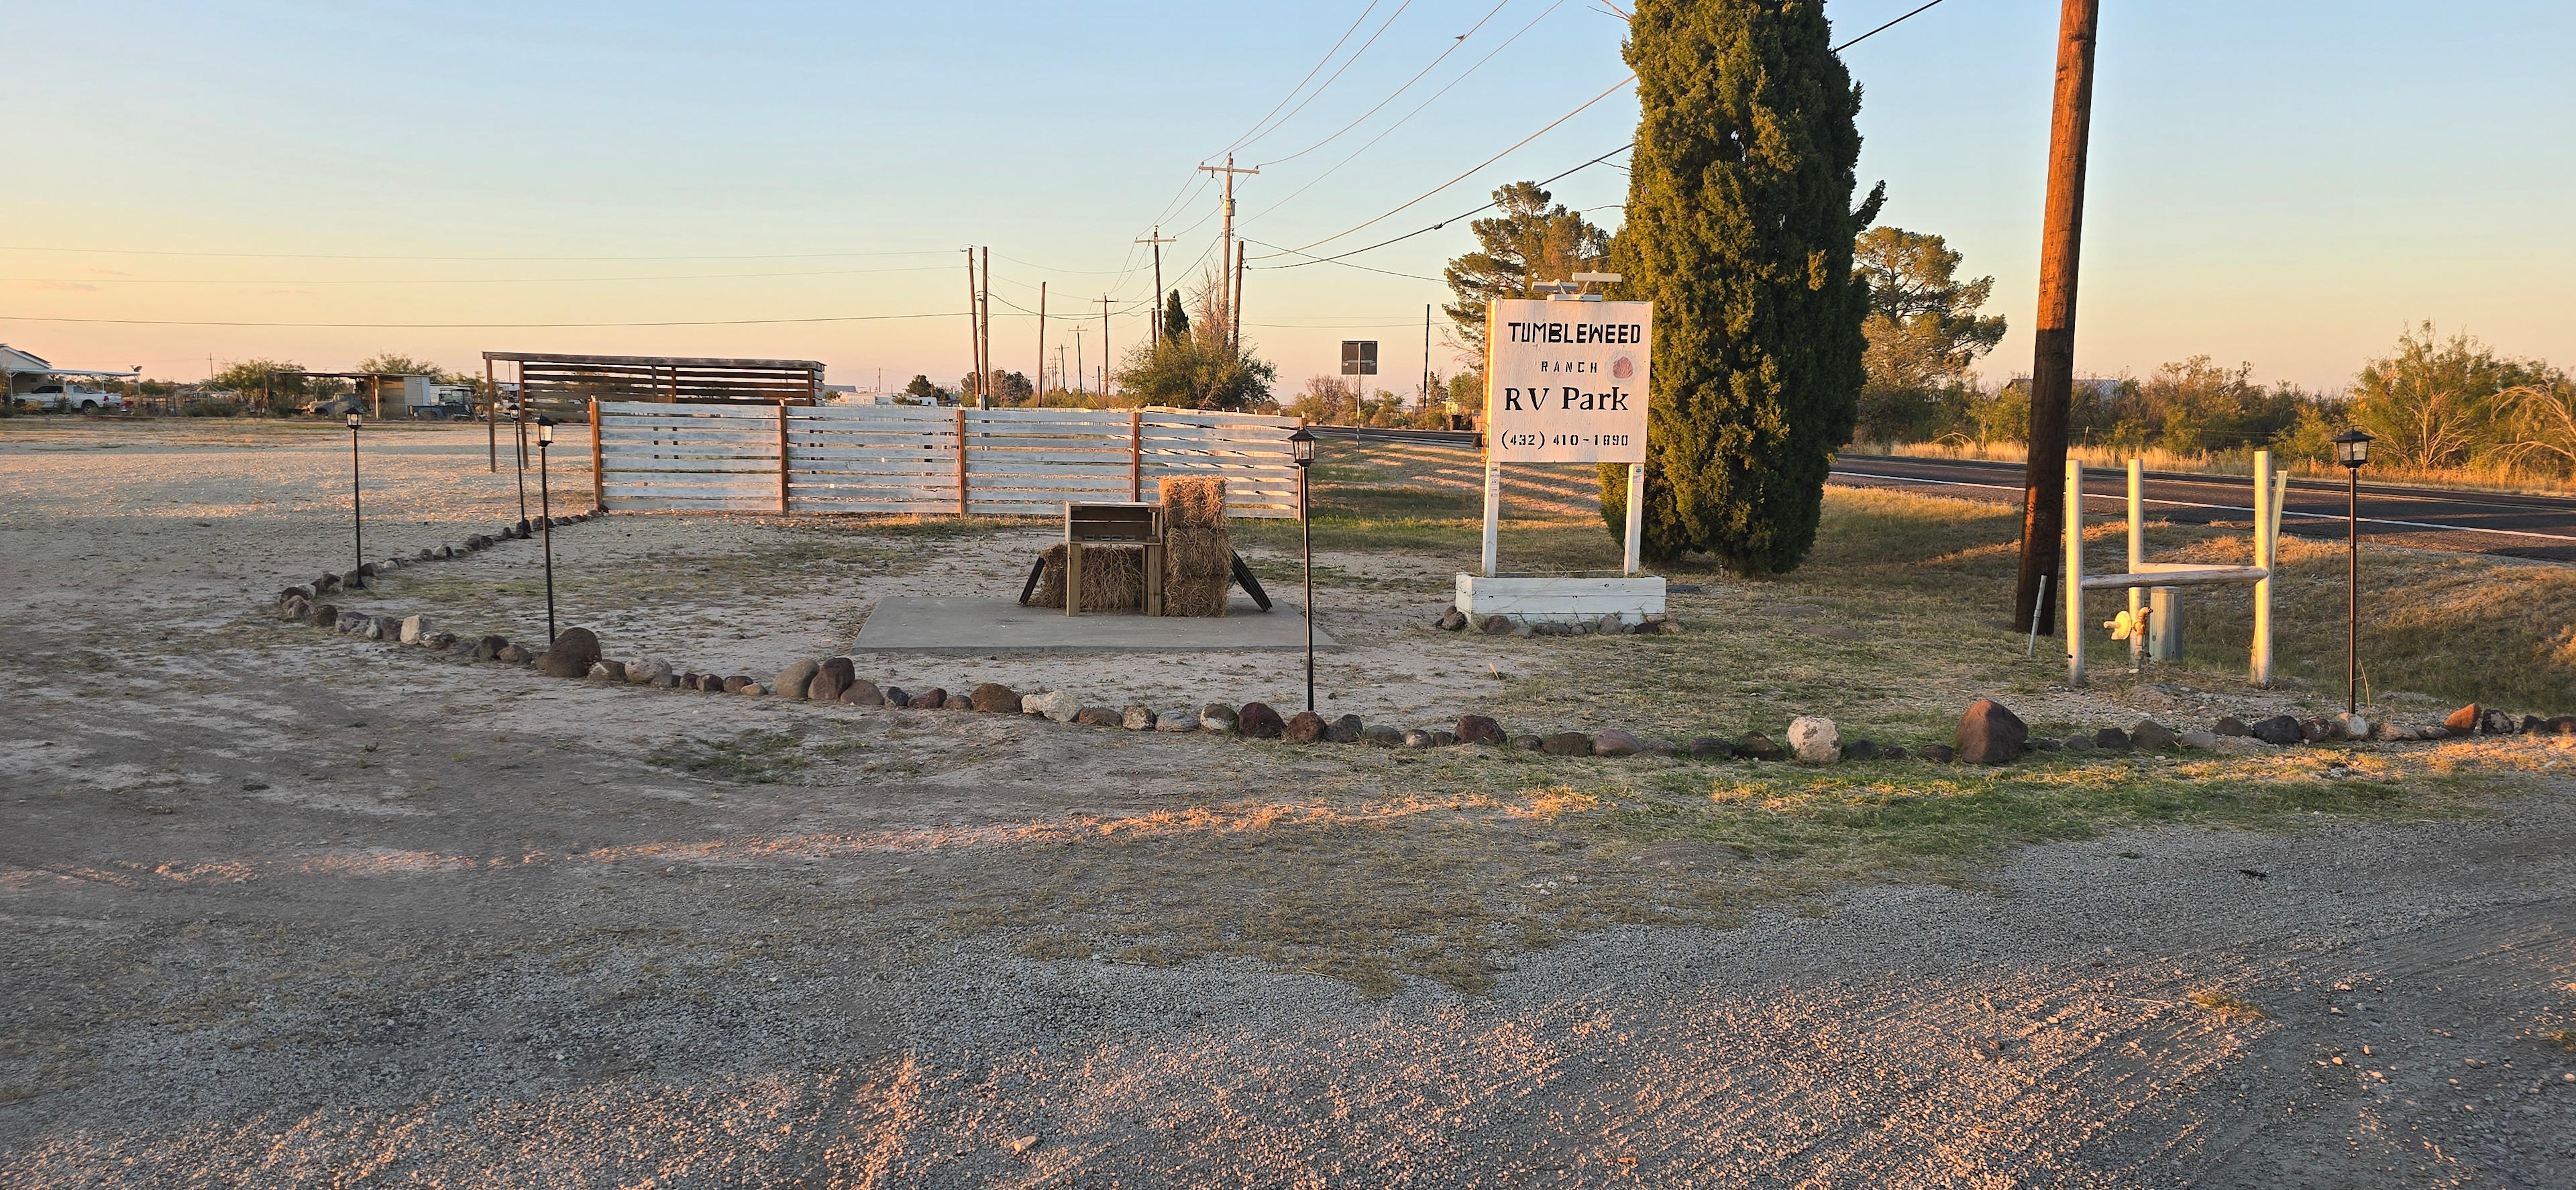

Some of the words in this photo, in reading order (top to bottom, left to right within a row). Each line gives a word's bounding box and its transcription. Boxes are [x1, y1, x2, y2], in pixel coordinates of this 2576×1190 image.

[1507, 322, 1641, 344] TUMBLEWEED
[1541, 361, 1598, 373] RANCH
[1505, 387, 1550, 411] RV
[1561, 386, 1629, 411] Park
[1501, 429, 1546, 450] (432)
[1552, 433, 1629, 447] 410-1890
